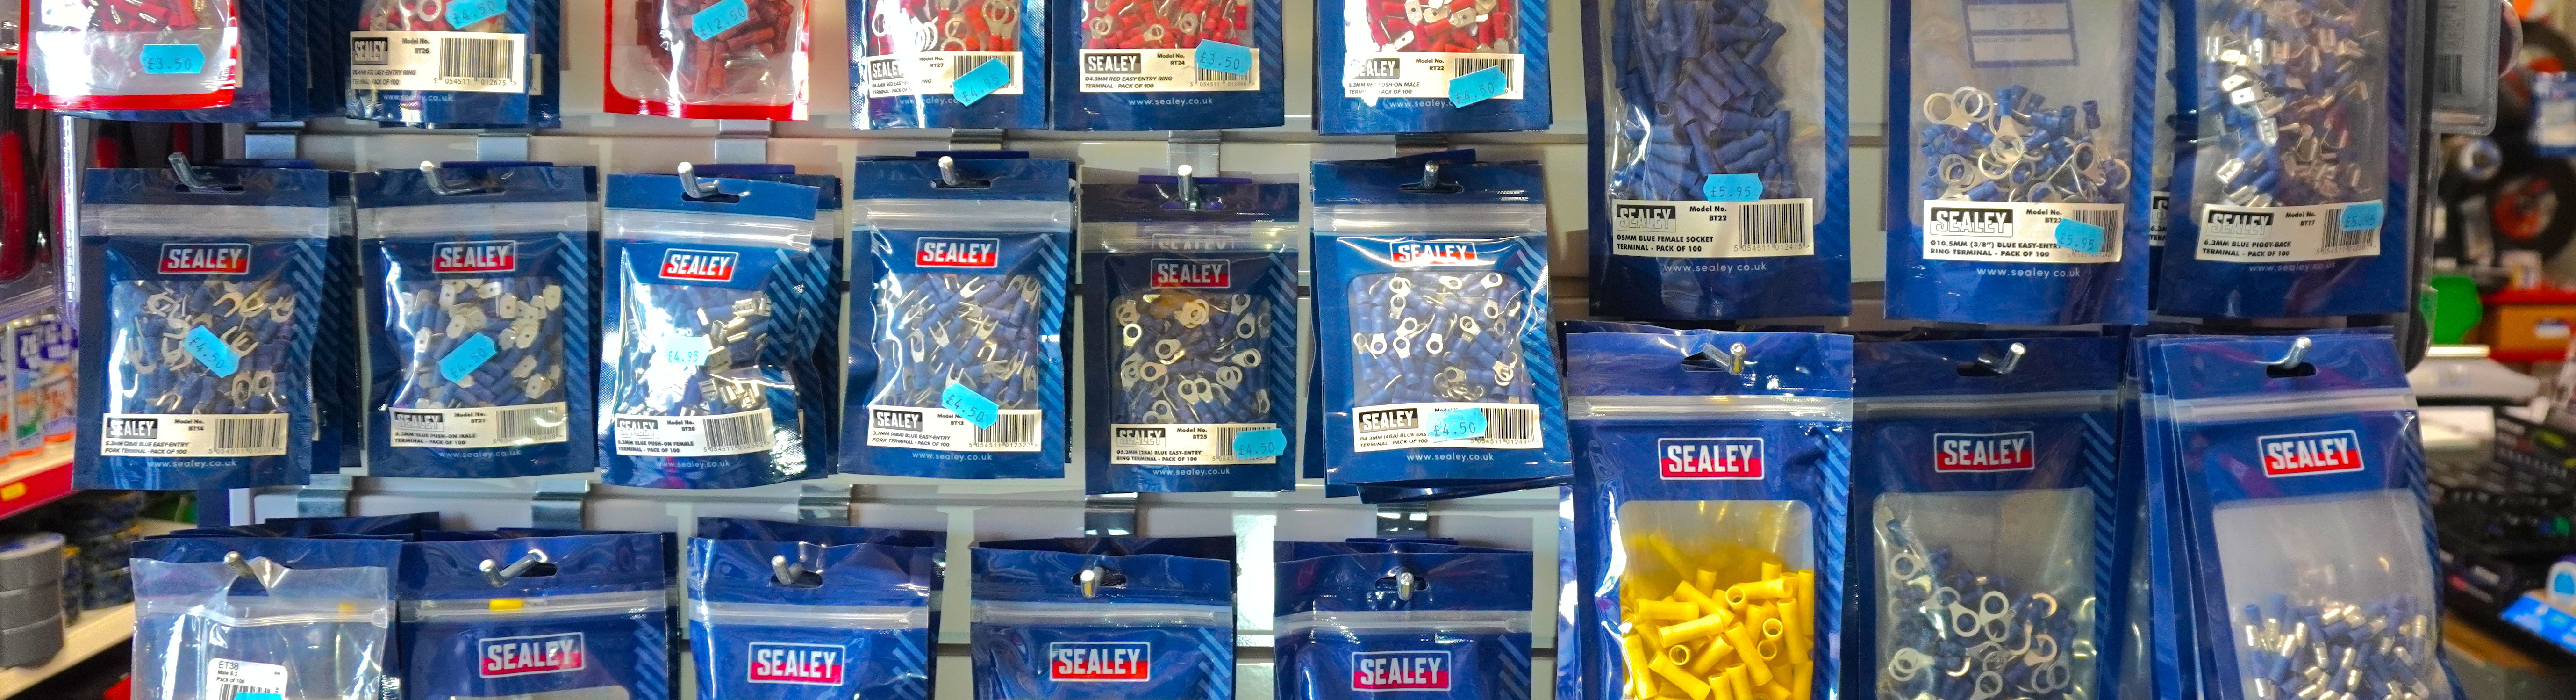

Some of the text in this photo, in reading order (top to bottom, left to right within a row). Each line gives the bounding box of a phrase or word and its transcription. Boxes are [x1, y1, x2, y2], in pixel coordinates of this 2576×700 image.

[453, 1, 495, 24] £4.50
[700, 8, 745, 36] £12.50
[355, 41, 386, 61] SEALEY
[147, 58, 191, 70] £3.50
[872, 61, 904, 78] SEALE
[1088, 56, 1136, 71] SEALEY
[1201, 52, 1239, 70] £3.50
[963, 74, 999, 101] £4.95
[1456, 82, 1494, 104] £4.50
[1129, 97, 1213, 106] www.sealey.co.uk
[1710, 186, 1750, 197] £5.95
[1620, 208, 1671, 229] SEALEY
[1937, 211, 2007, 233] SEALEY
[2211, 214, 2270, 235] SEALEY
[2060, 233, 2094, 250] £5.95
[167, 249, 242, 269] SEALEY
[440, 246, 509, 268] SEALEY
[922, 242, 991, 263] SEALEY
[1398, 245, 1467, 261] SEALEY
[668, 254, 730, 276] SEALEY
[1158, 263, 1223, 283] SEALEY
[1664, 262, 1766, 273] www.sealeyco.uk
[1976, 268, 2080, 279] www.sealeyco.uk
[188, 337, 224, 368] £4.50
[450, 348, 486, 378] £4.50
[946, 395, 984, 422] £4.50
[110, 420, 154, 436] SEALEY
[398, 413, 439, 430] SEALEY
[619, 420, 654, 436] SEALEY
[876, 412, 919, 429] SEALEY
[1363, 411, 1414, 430] SEALEY
[1434, 422, 1475, 437] £4.50
[1119, 430, 1161, 445] SEALEY
[440, 449, 521, 457] www.sealey.co.uk
[912, 452, 992, 462] www.sealey.co.uk
[1239, 443, 1274, 455] £4.50
[1407, 453, 1494, 462] www.sealey.co.uk
[1667, 444, 1753, 473] SEALEY
[1944, 438, 2025, 465] SEALEY
[2268, 437, 2350, 471] SEALEY
[148, 460, 236, 468] www.sealey.co.uk
[488, 639, 575, 671] SEALEY
[757, 649, 837, 678] SEALEY
[1059, 648, 1140, 675] SEALEY
[219, 661, 239, 670] ET38
[1360, 657, 1441, 685] SEALEY
